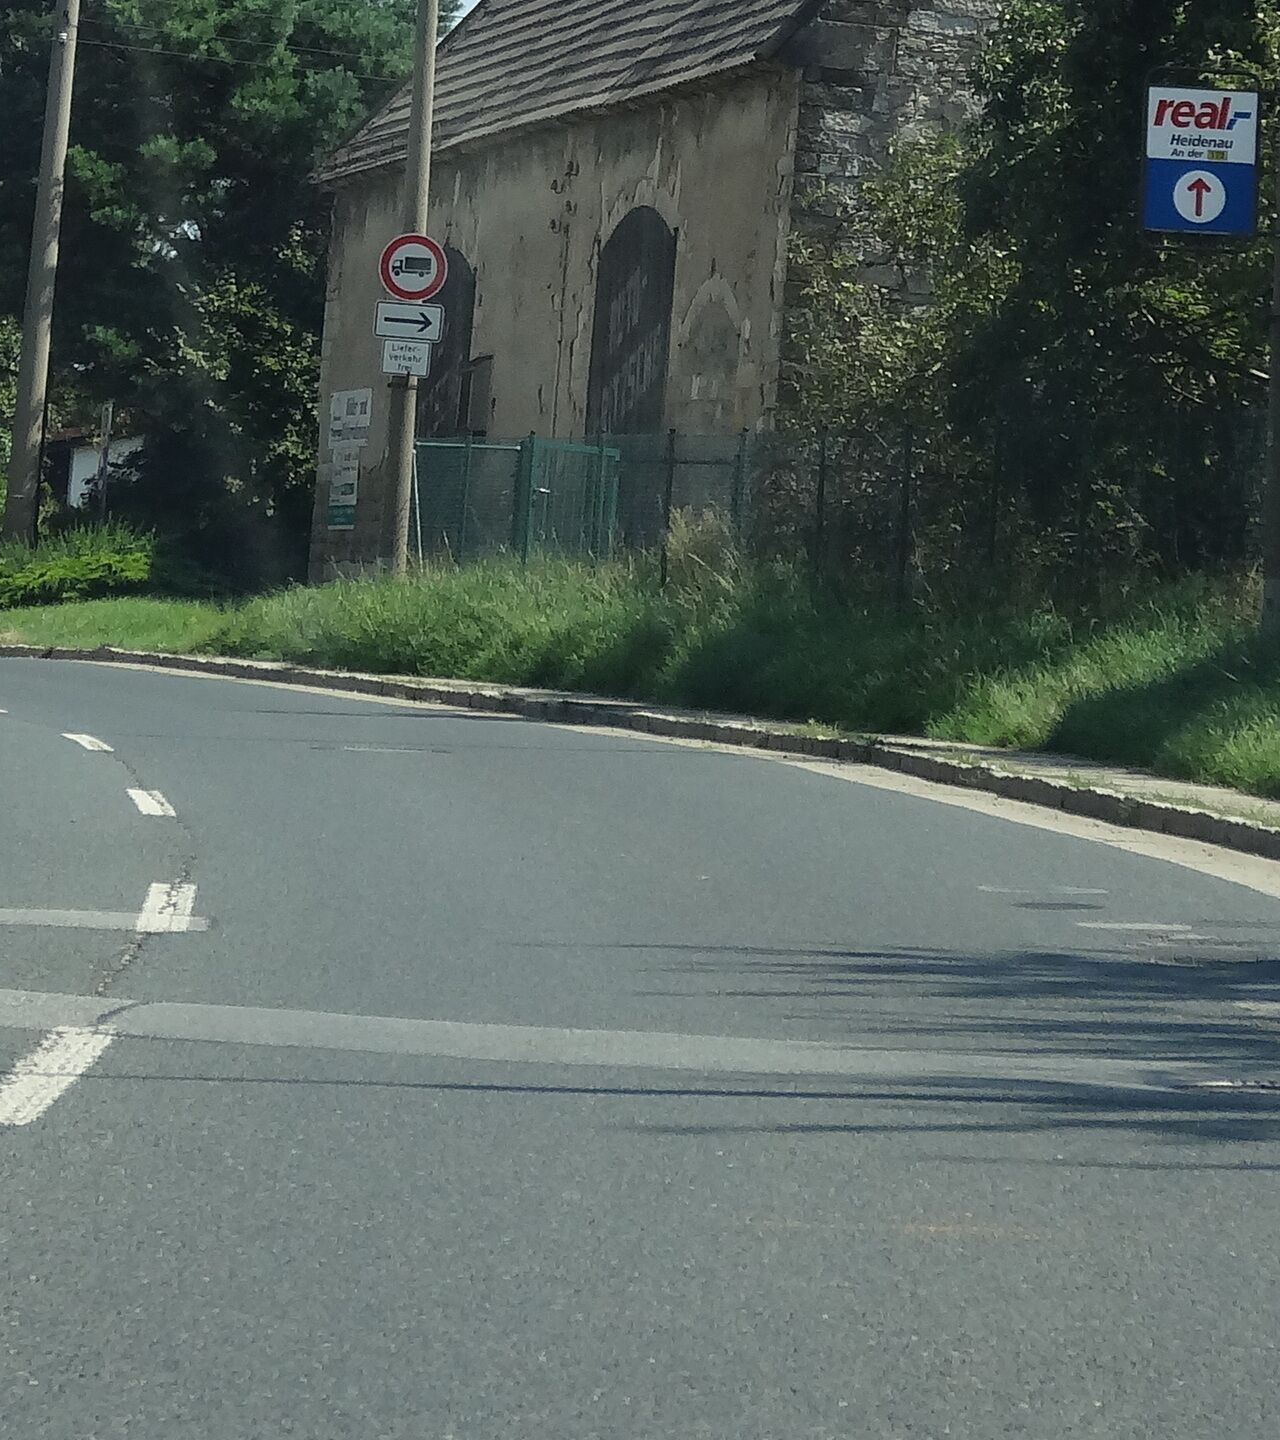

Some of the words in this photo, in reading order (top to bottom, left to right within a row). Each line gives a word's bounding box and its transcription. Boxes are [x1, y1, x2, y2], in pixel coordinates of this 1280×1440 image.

[1170, 134, 1233, 148] Heidenau
[1171, 149, 1184, 157] An
[1188, 150, 1204, 158] der
[389, 354, 422, 363] verkehr
